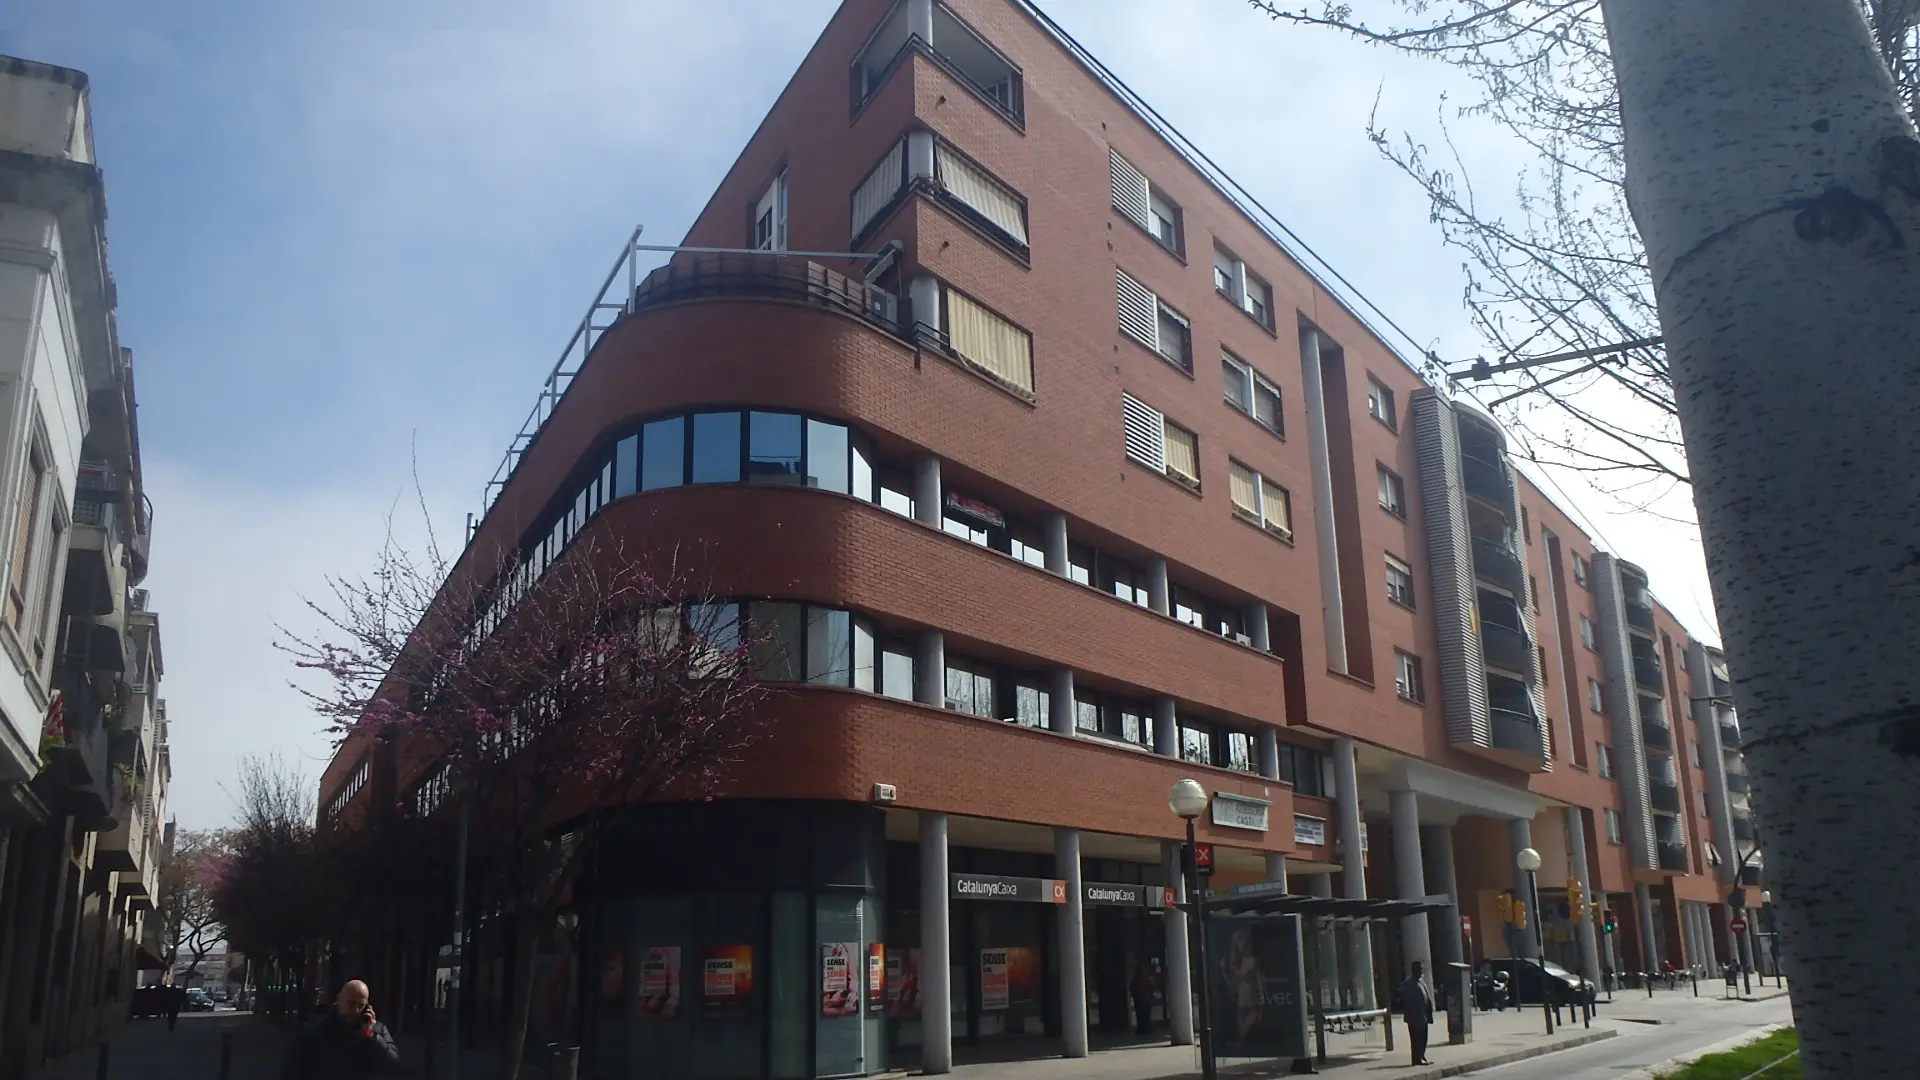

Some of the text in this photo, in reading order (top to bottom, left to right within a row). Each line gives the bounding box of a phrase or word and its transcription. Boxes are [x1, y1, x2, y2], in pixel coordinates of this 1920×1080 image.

[957, 879, 1017, 896] CatalunyaCaixa
[1054, 885, 1065, 898] CX
[1088, 887, 1135, 902] CatalunyaCaixa
[826, 958, 845, 966] SENSE
